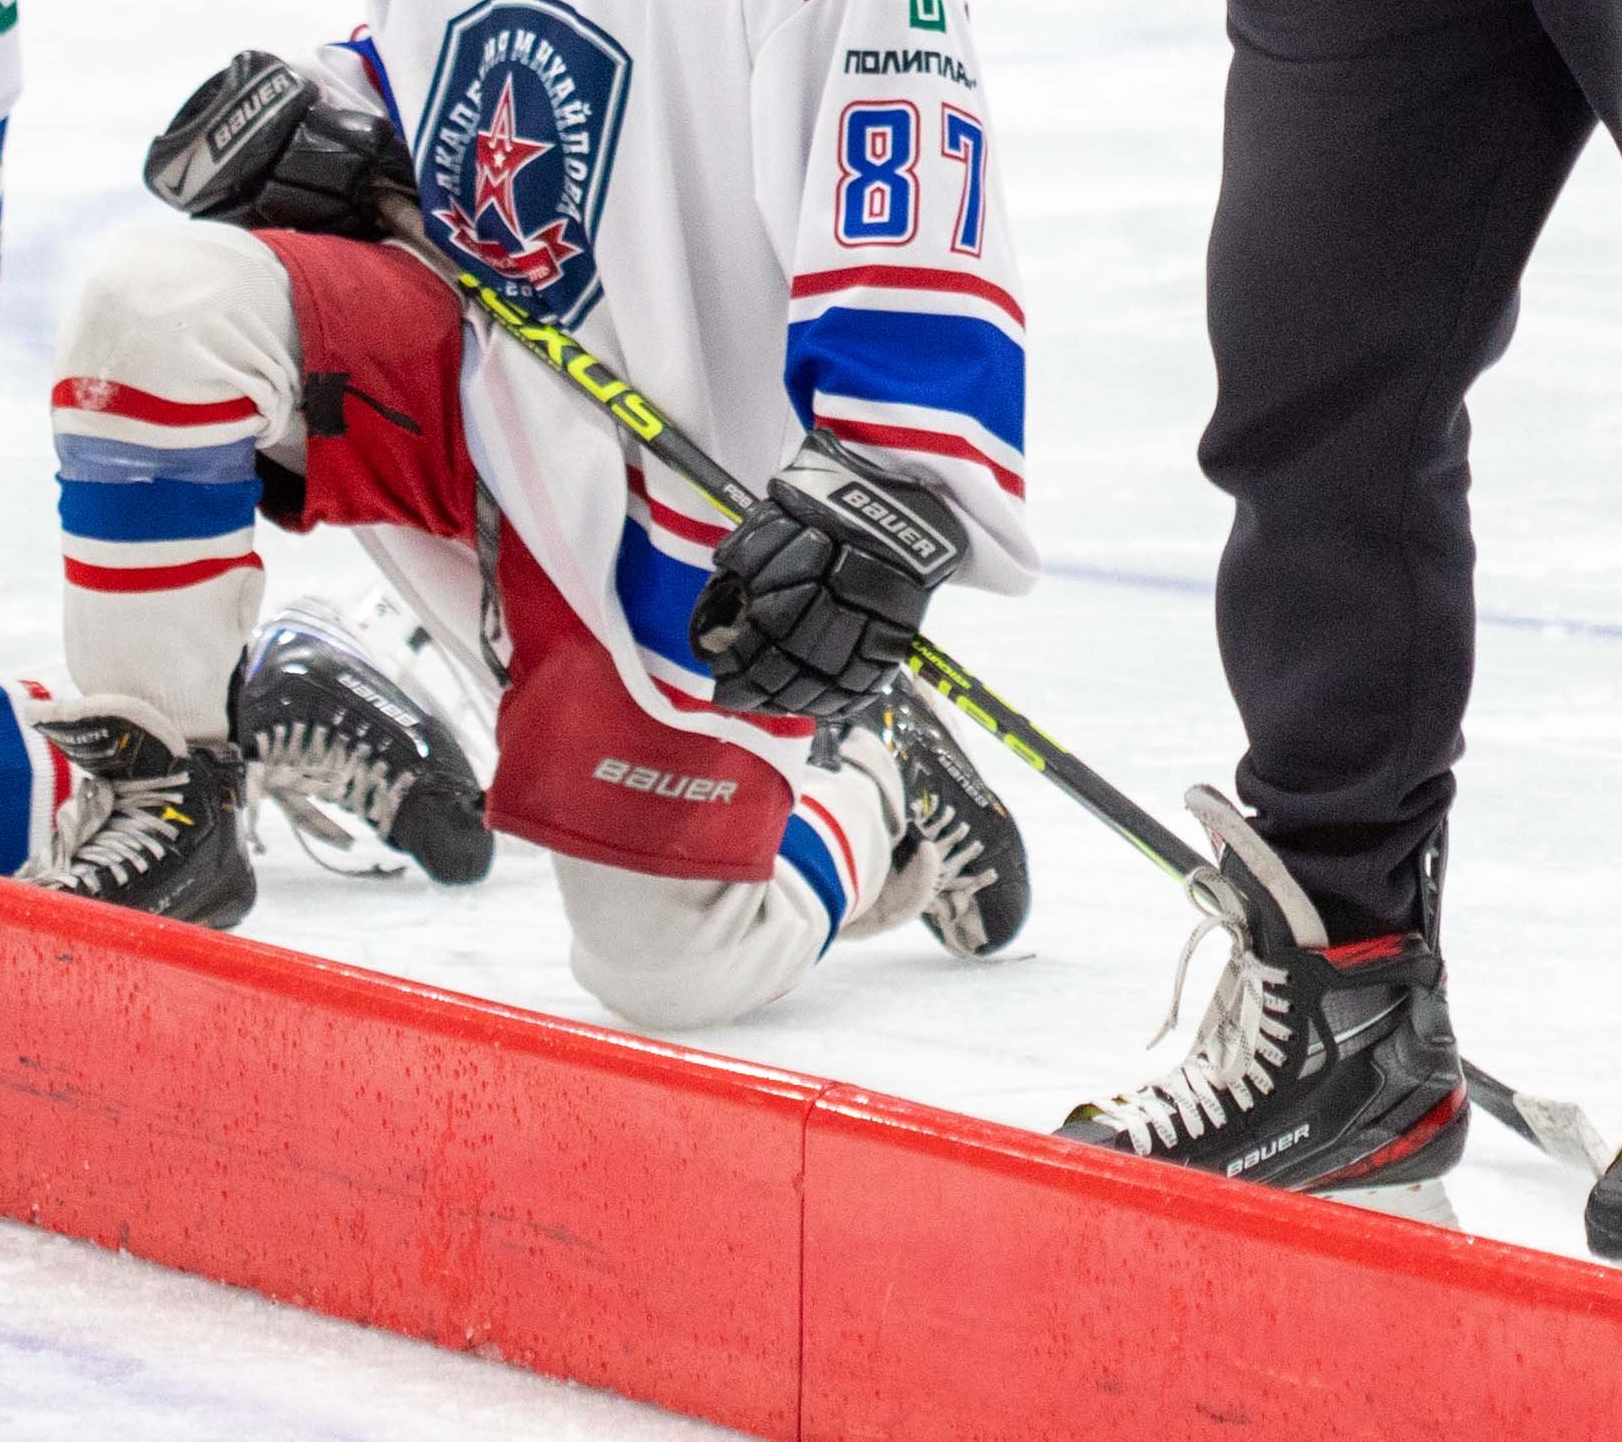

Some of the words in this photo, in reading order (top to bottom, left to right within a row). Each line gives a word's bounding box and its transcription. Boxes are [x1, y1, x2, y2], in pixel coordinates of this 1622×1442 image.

[214, 74, 290, 151] BAUER
[834, 98, 988, 260] 87
[841, 487, 936, 559] BAUER
[592, 755, 738, 806] BAUER
[1227, 1123, 1310, 1179] BAUER
